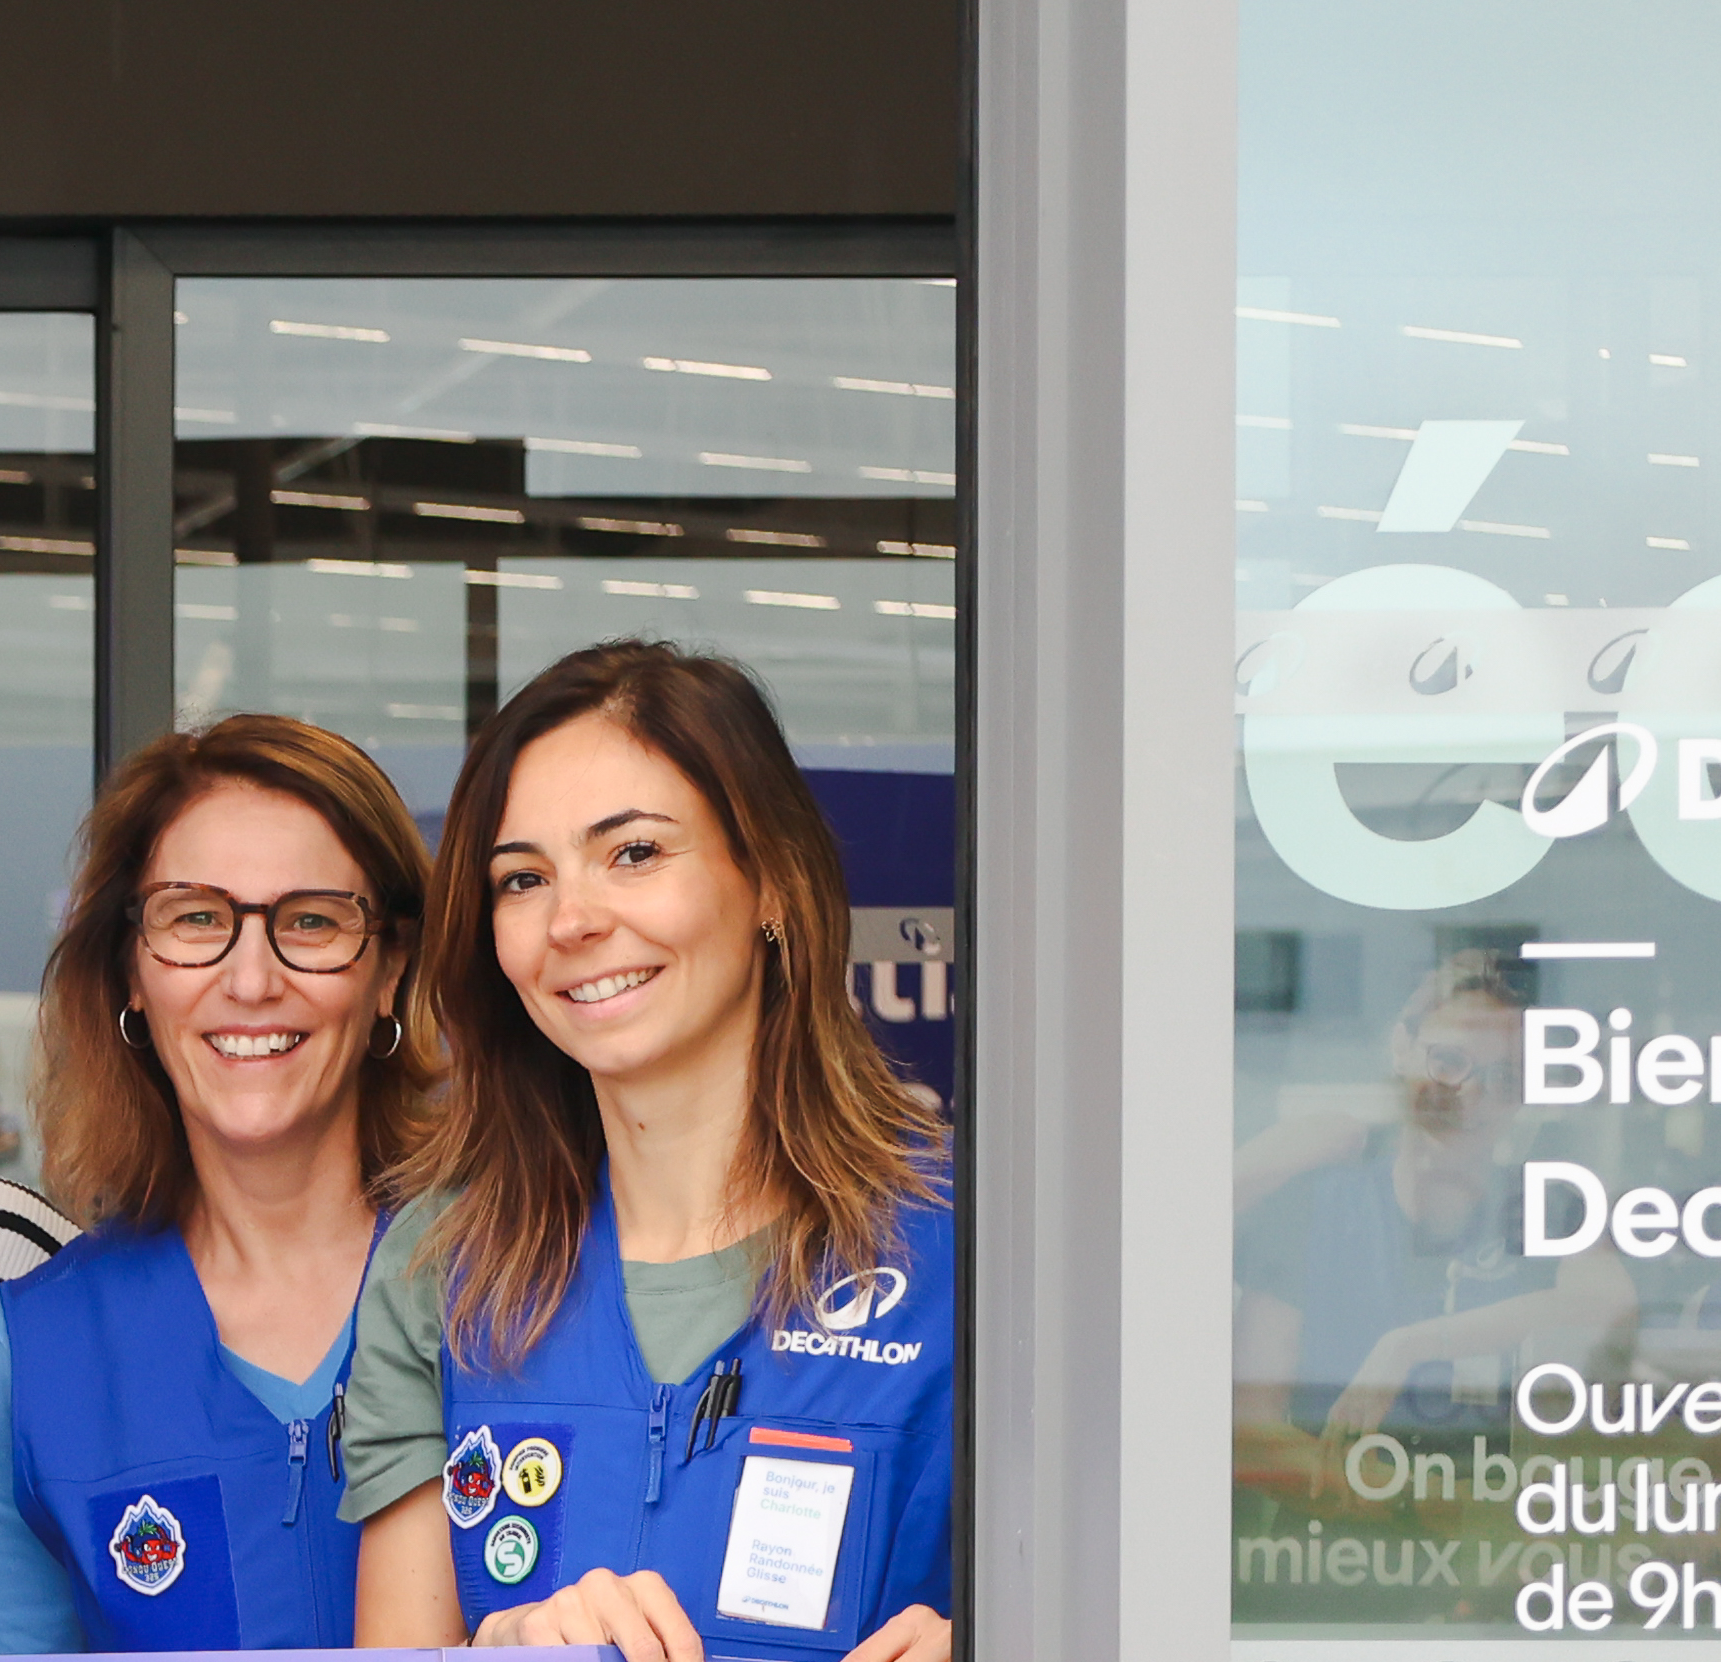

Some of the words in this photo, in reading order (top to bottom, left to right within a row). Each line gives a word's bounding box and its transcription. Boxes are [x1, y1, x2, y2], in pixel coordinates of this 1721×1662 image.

[1522, 1006, 1721, 1105] Bie
[770, 1329, 923, 1366] DECATHLON
[765, 1470, 820, 1493] Bonjour,
[822, 1480, 836, 1494] je
[1345, 1432, 1457, 1502] On
[762, 1485, 790, 1499] suis
[1516, 1464, 1616, 1534] du
[759, 1498, 822, 1520] Charlotte
[751, 1538, 793, 1557] Rayon
[1237, 1518, 1461, 1587] mieux
[746, 1566, 788, 1584] Glisse
[748, 1552, 825, 1577] Randonnée
[1516, 1562, 1614, 1632] de
